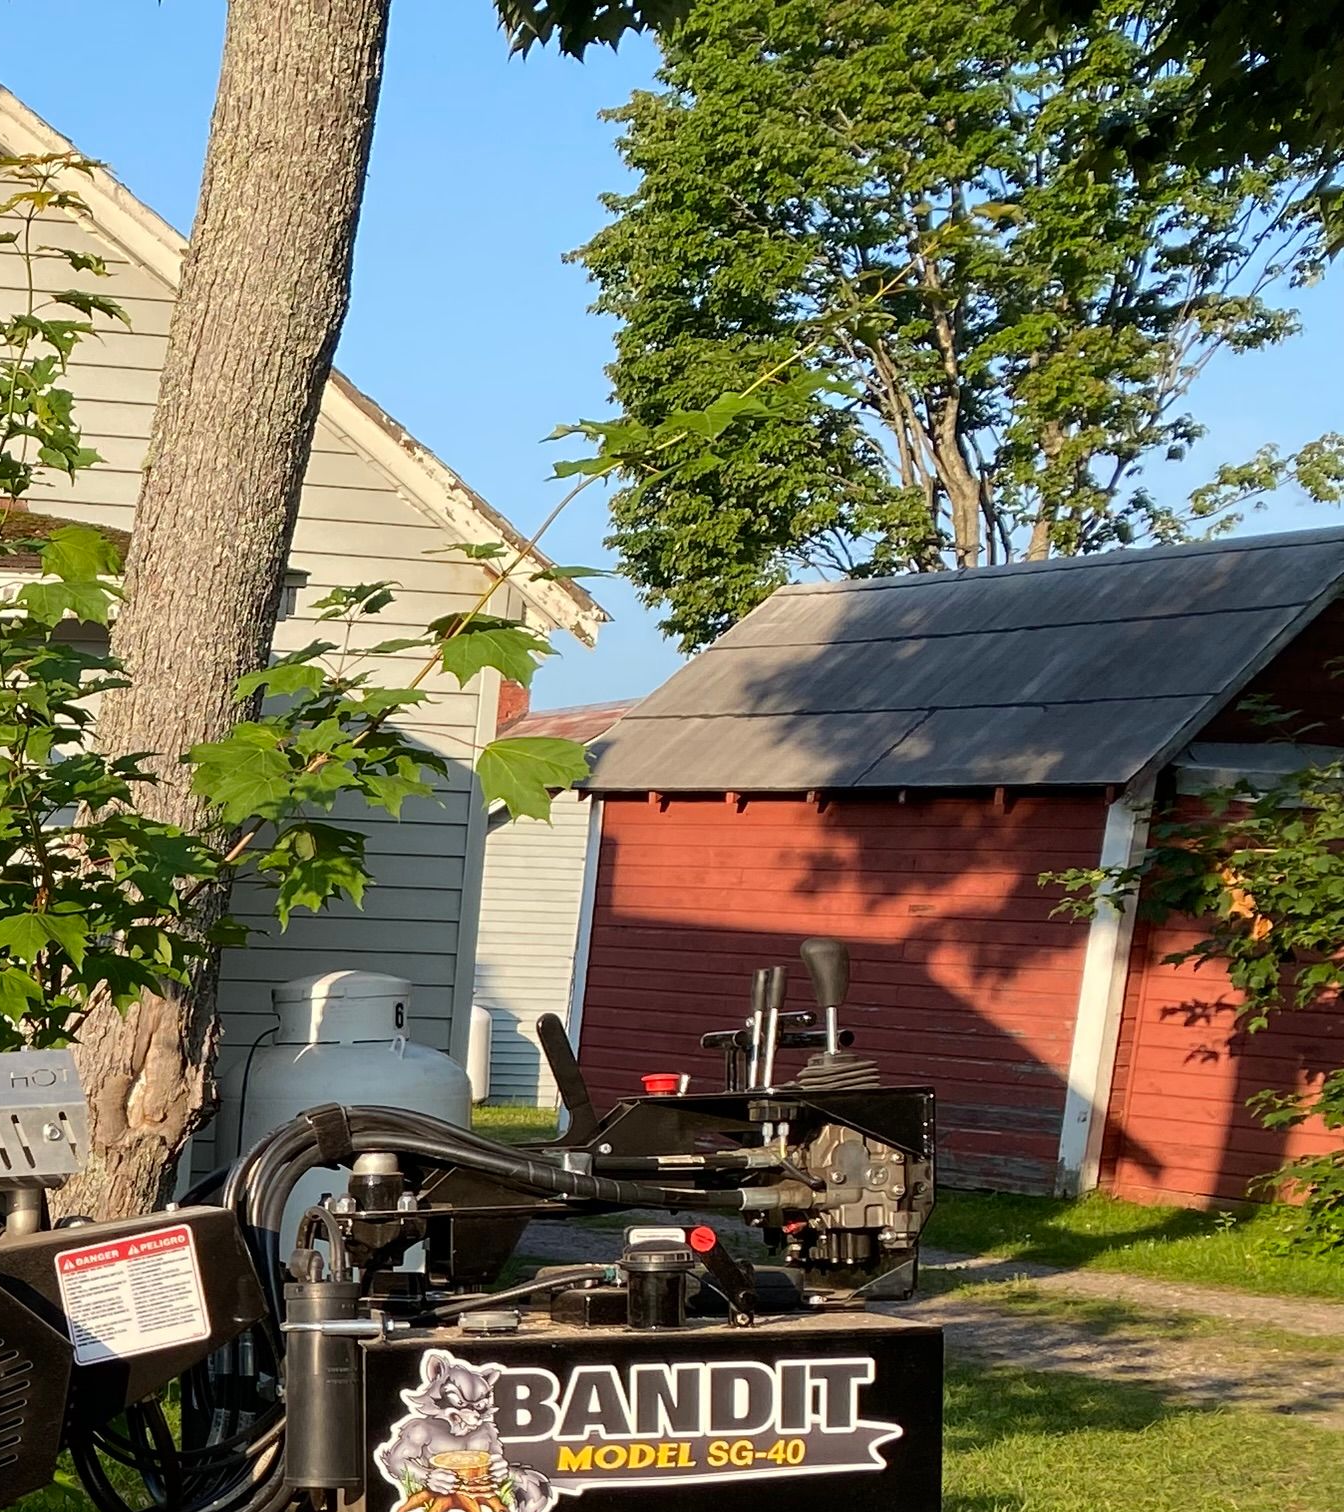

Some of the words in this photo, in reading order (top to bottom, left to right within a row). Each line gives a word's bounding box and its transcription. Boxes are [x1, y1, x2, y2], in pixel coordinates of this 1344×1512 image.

[395, 1002, 404, 1029] 6
[10, 1067, 69, 1088] HOT
[75, 1249, 119, 1266] DANGER
[140, 1234, 185, 1252] PELIGRO
[499, 1362, 870, 1437] BANDIT
[556, 1442, 696, 1472] MODEL
[707, 1438, 806, 1468] SG-40
